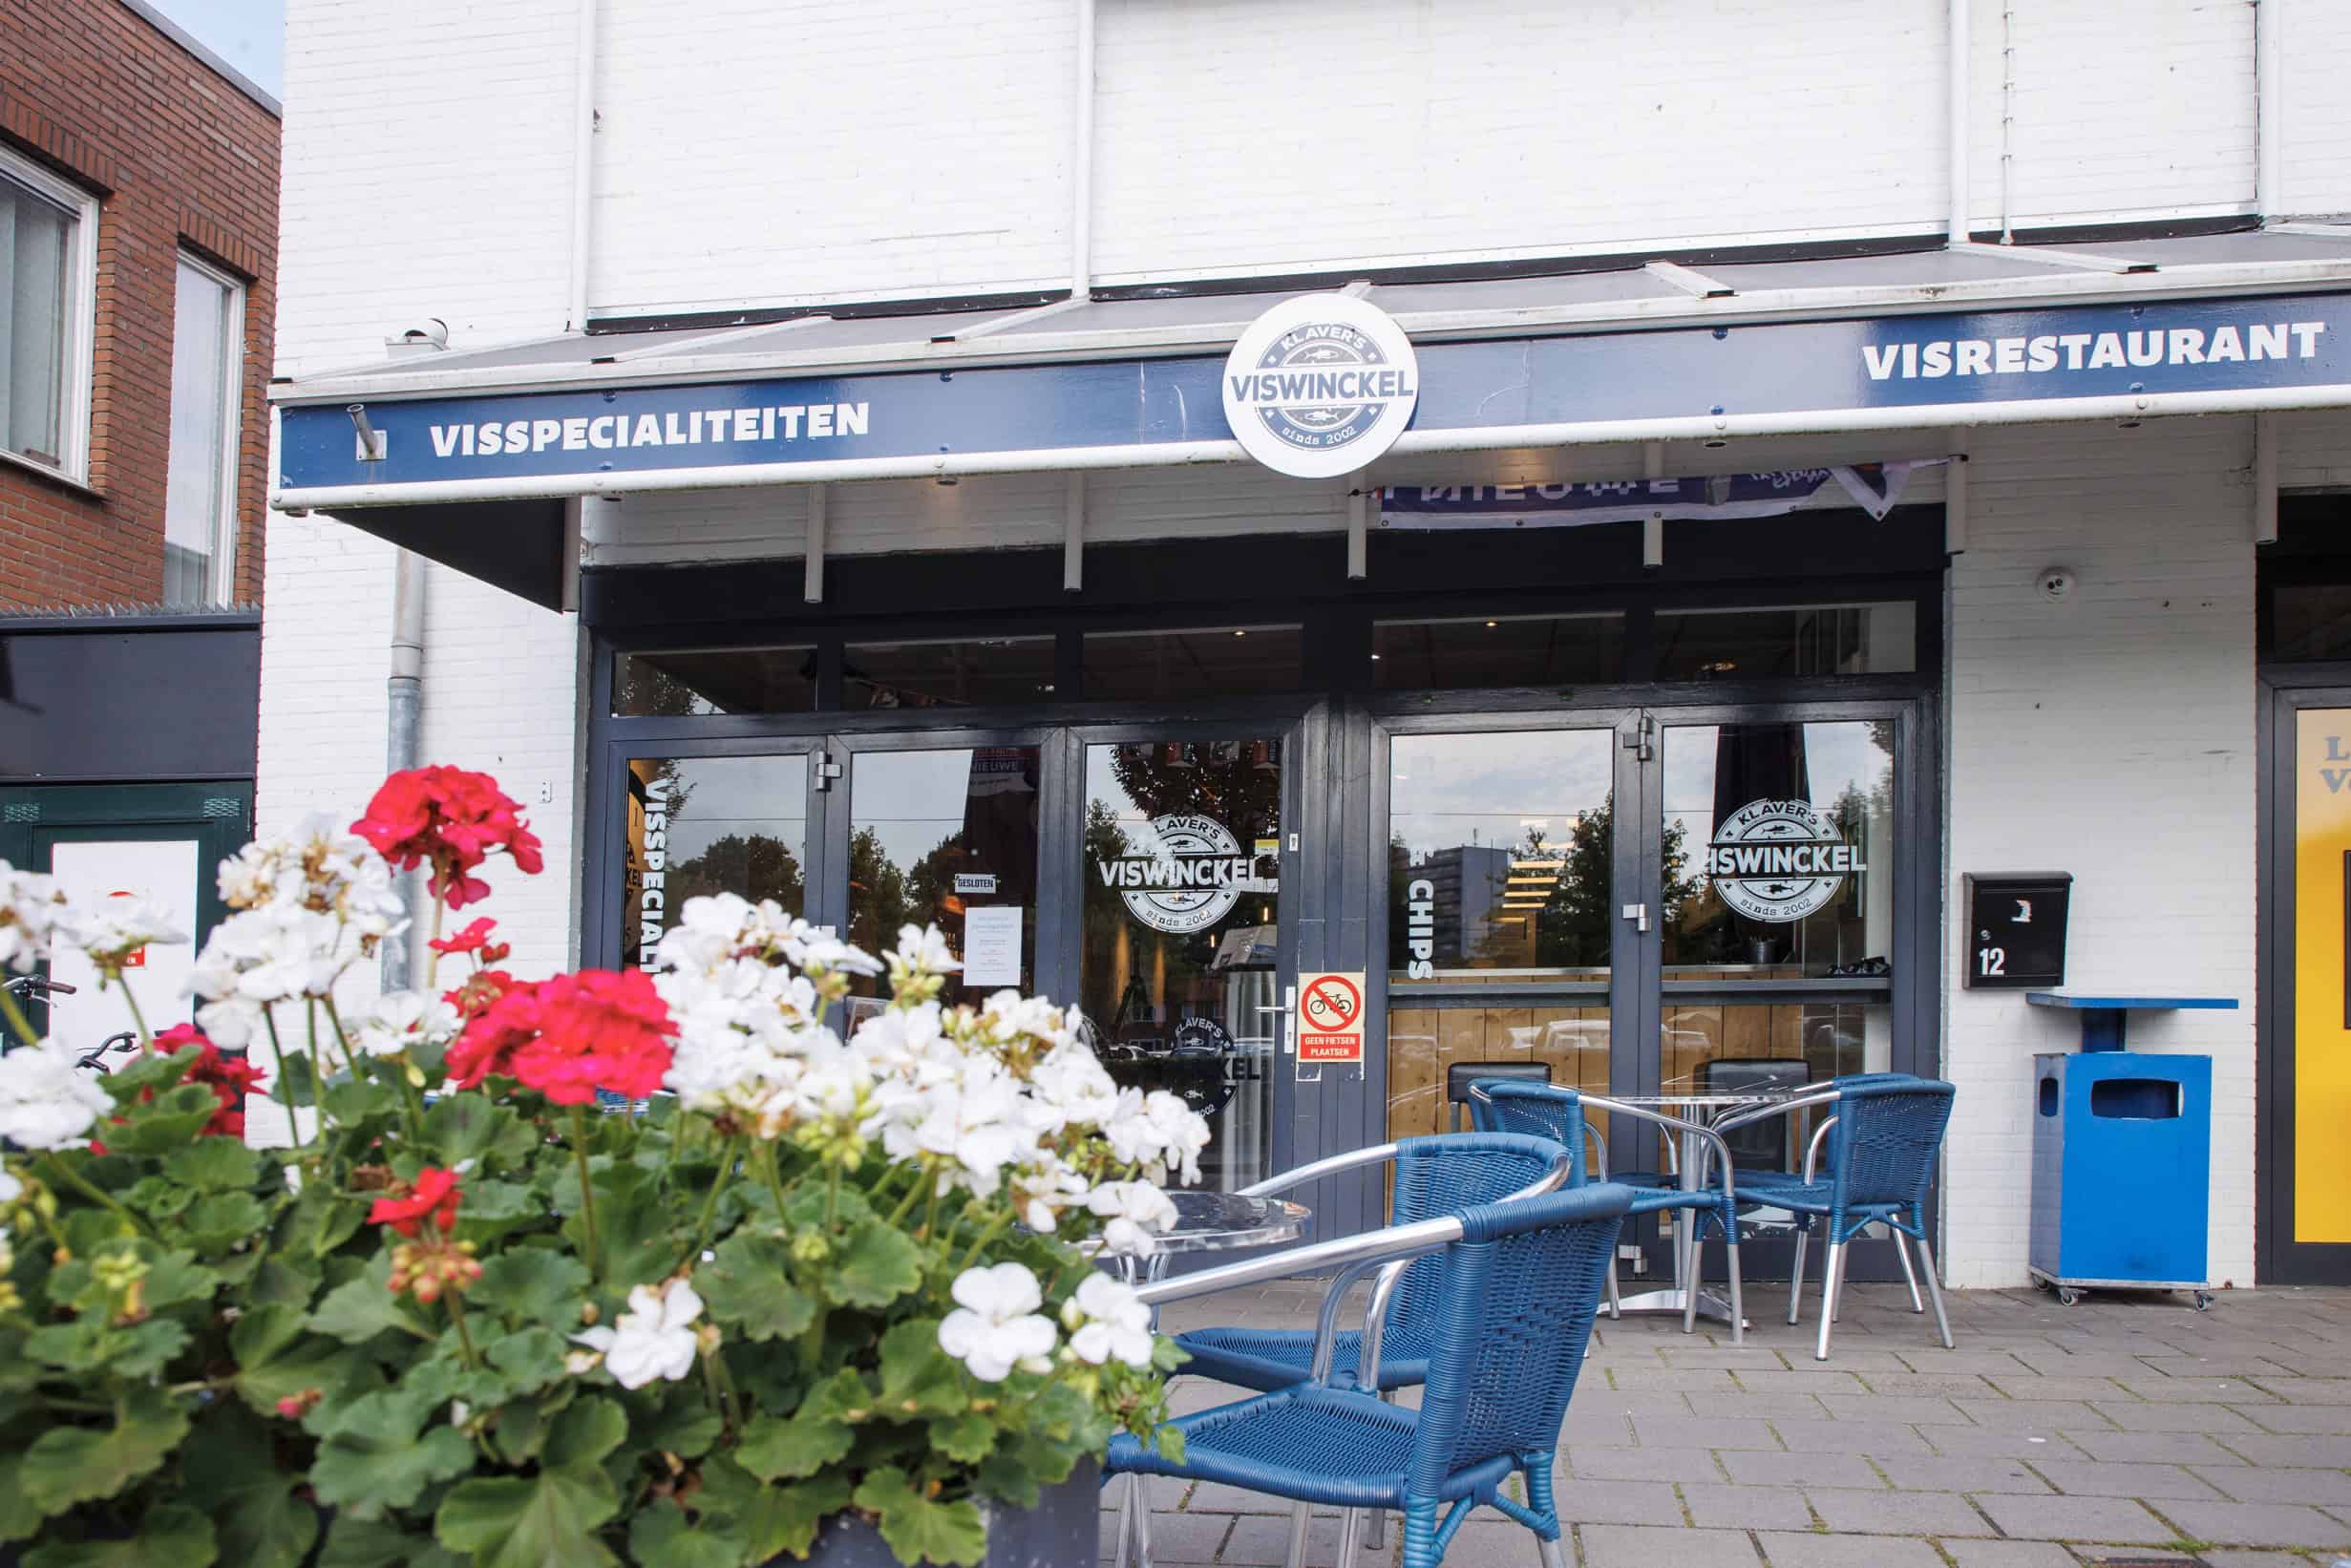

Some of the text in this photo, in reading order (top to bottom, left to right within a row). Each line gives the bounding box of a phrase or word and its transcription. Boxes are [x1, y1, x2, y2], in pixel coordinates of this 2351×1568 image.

[1280, 325, 1367, 351] KLAVER'S
[1863, 321, 2325, 381] VISRESTAURANT
[1230, 370, 1414, 402] VISWINCKEL
[429, 402, 870, 458] VISSPECIALITEITEN
[1281, 426, 1359, 445] sinds 2002
[2319, 768, 2351, 795] V
[1736, 801, 1819, 826] KLAVER'S
[1154, 818, 1222, 840] LAVER'S
[1098, 858, 1262, 887] VISWINCKEL
[1708, 844, 1868, 875] ISWINCKEL
[957, 879, 994, 888] GESLOTEN
[1145, 910, 1181, 926] sinds
[1739, 898, 1814, 917] sinds 2002
[1408, 879, 1434, 980] CHIPS
[1979, 946, 2005, 976] 12
[1304, 1037, 1356, 1046] GEEN FIETSEN
